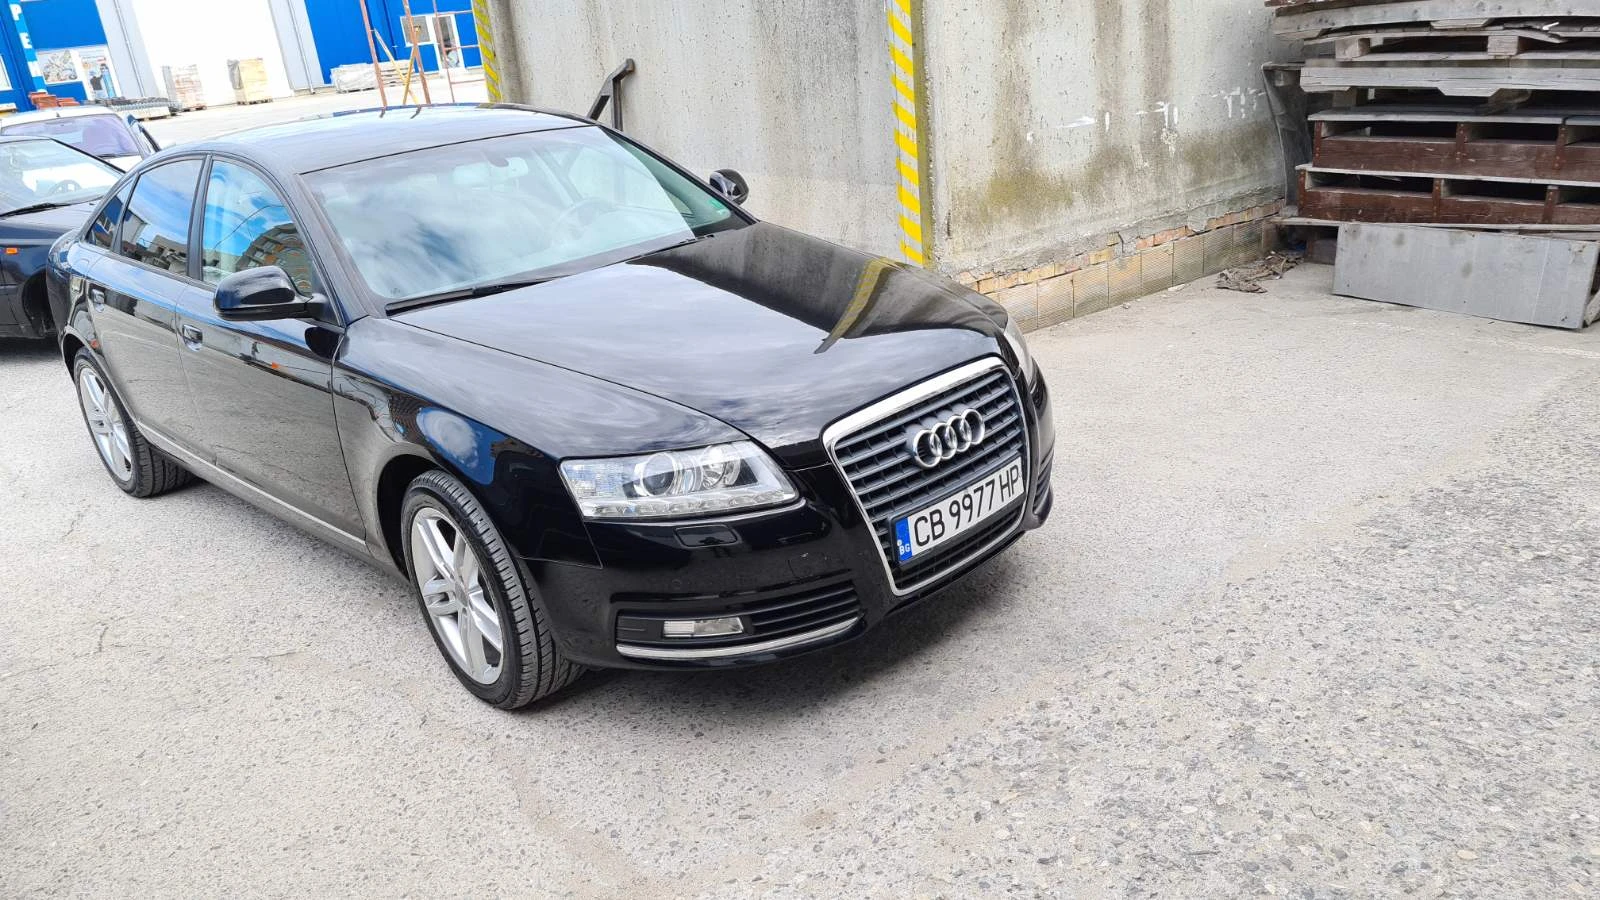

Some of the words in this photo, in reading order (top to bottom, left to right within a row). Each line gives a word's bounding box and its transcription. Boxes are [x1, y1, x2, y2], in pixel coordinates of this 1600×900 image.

[914, 509, 945, 547] CB
[949, 480, 995, 529] 9977
[999, 465, 1019, 502] HP
[899, 545, 911, 555] BG
